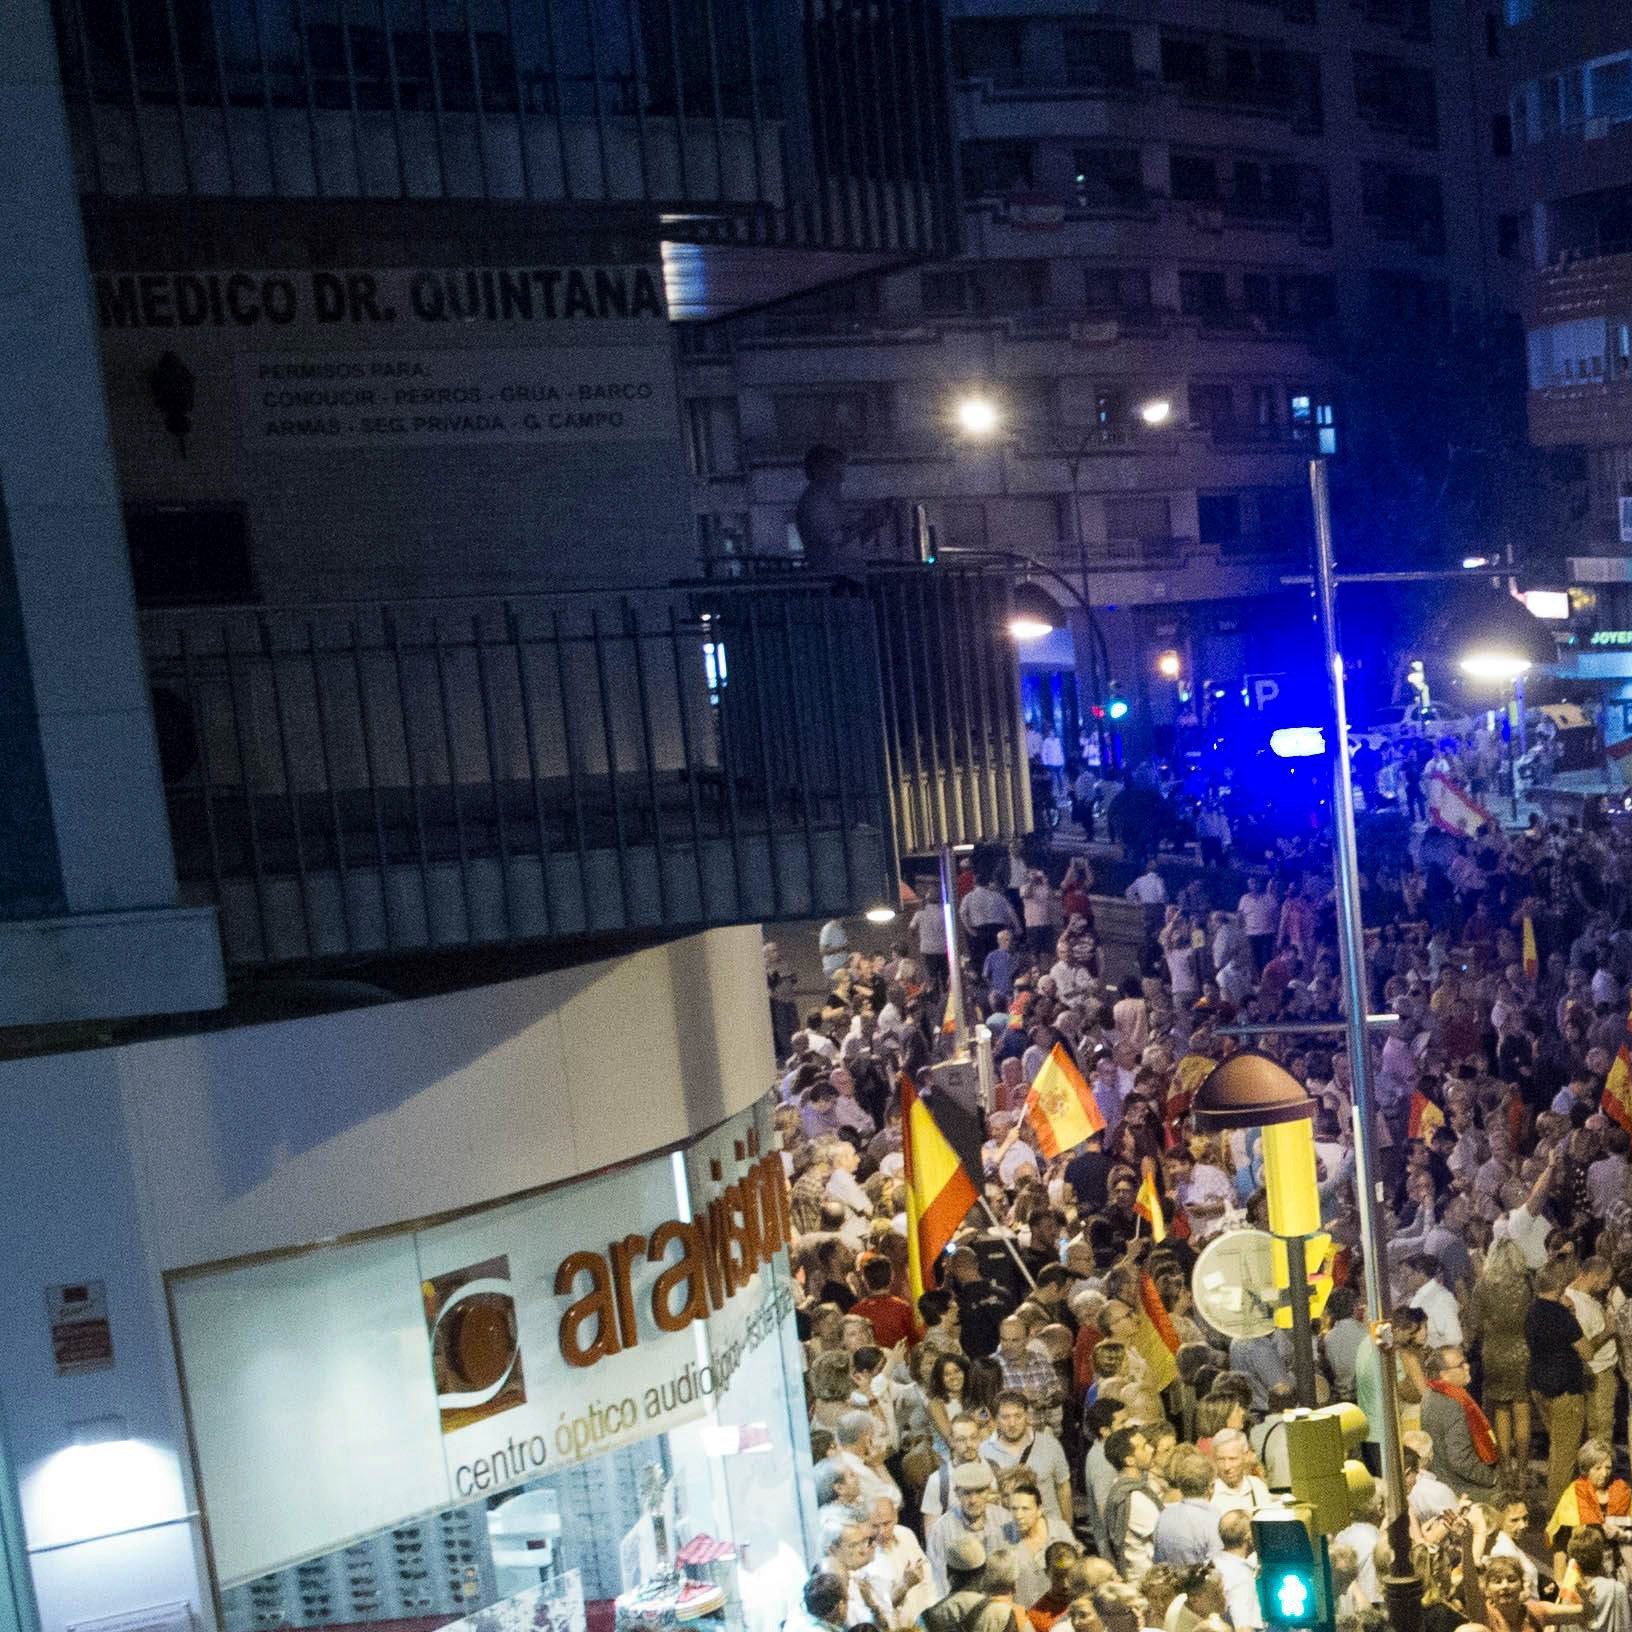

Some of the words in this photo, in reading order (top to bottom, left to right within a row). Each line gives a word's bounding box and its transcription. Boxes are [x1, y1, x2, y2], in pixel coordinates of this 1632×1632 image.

[98, 273, 297, 327] MEDICO
[313, 272, 397, 324] DR.
[410, 268, 662, 322] QUINTANA
[263, 390, 374, 408] CONDUCIR
[394, 387, 481, 405] PERROS
[578, 383, 653, 400] BARCO
[265, 419, 342, 436] ARMAS
[413, 415, 503, 433] PRIVADA
[549, 411, 625, 430] CAMPO
[456, 1435, 547, 1497] centro
[555, 1397, 638, 1461] óptico
